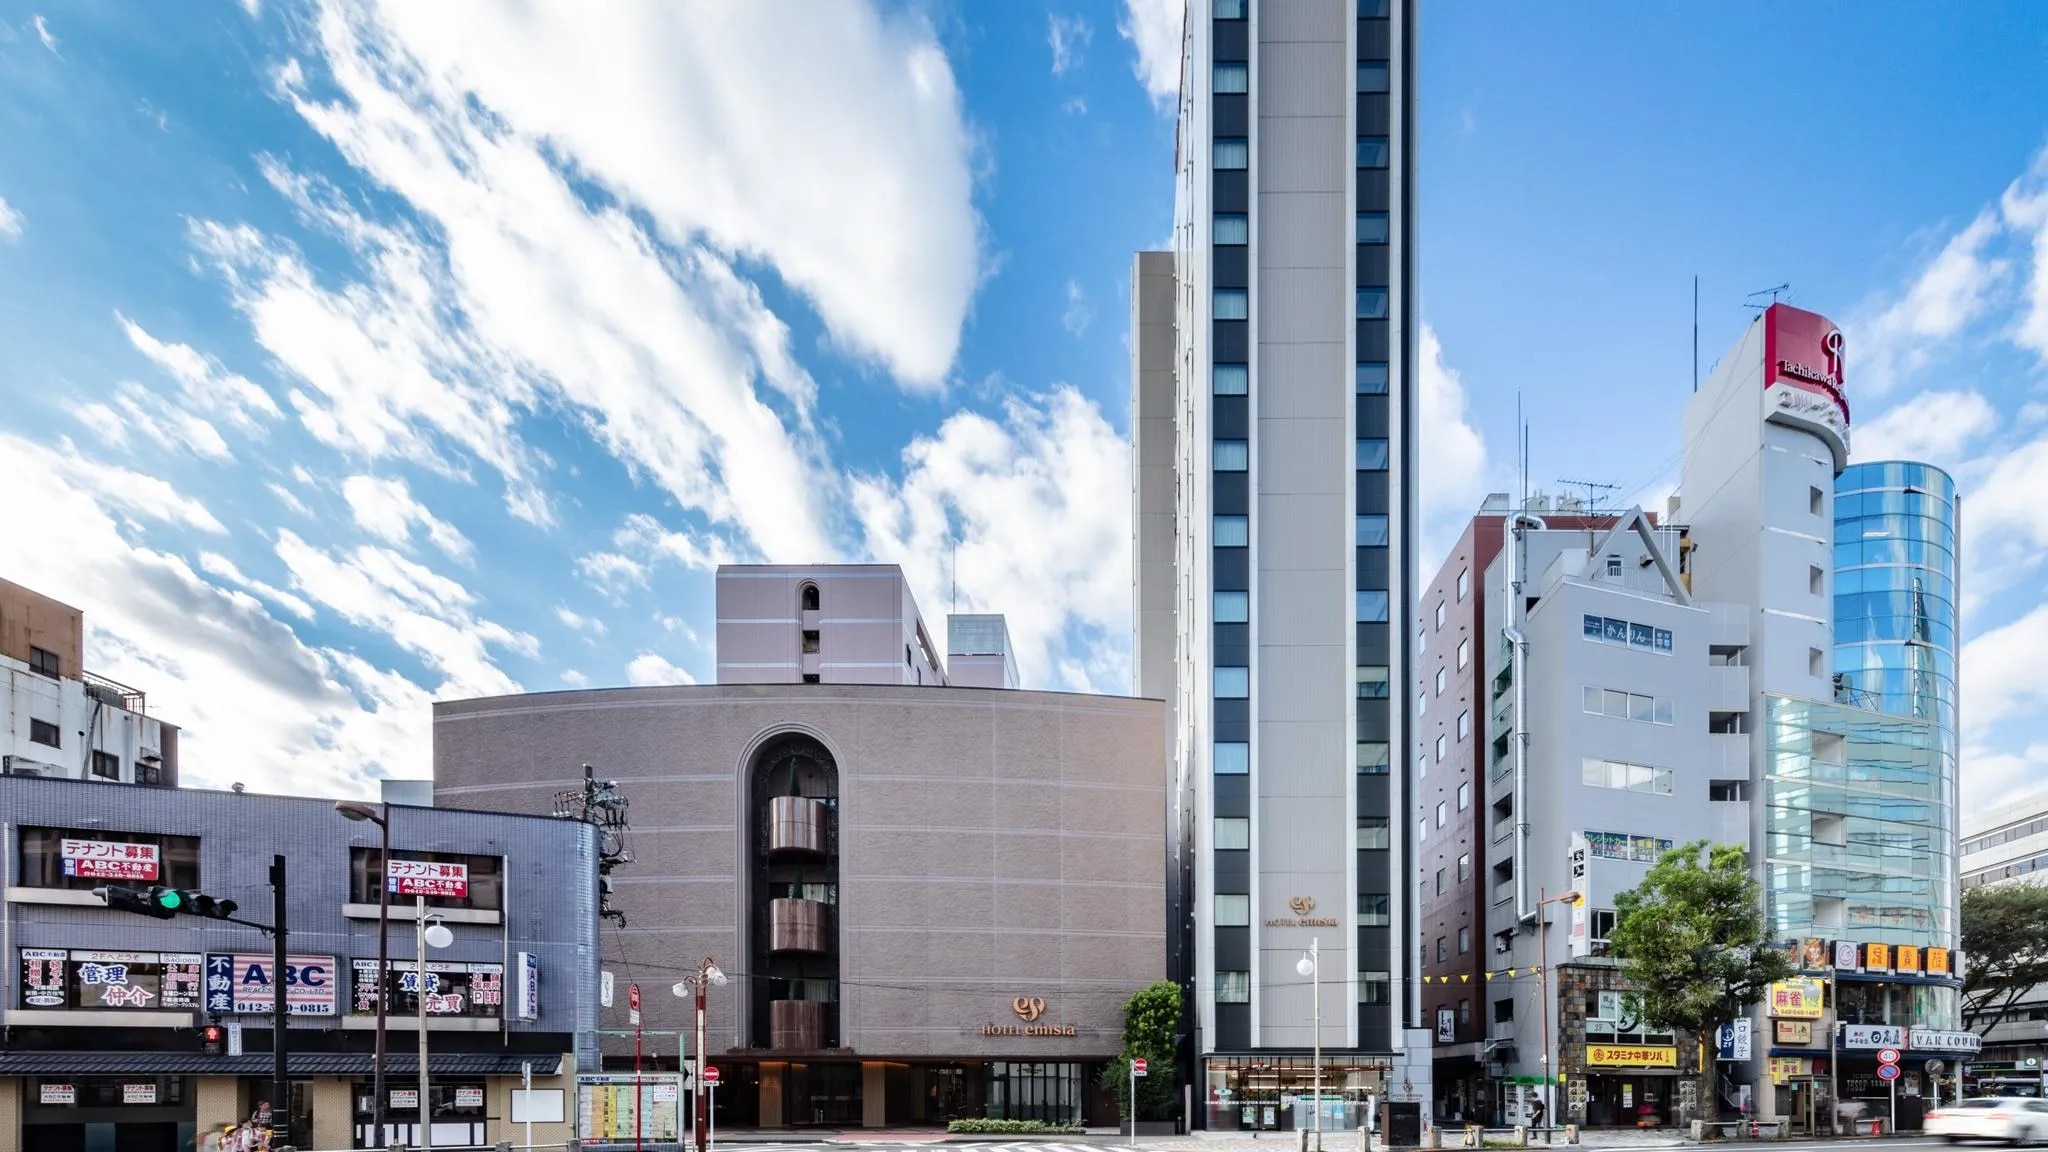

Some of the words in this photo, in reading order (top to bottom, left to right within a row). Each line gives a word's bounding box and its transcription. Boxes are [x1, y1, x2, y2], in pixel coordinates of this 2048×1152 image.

[1783, 360, 1833, 386] Tachikawa
[66, 842, 154, 859] テナント募集
[81, 860, 152, 872] ABC不動産
[391, 862, 464, 877] テナント募集
[402, 879, 463, 889] ABC不動産
[81, 963, 128, 984] 管理
[242, 964, 326, 987] ABC
[208, 956, 231, 1010] 不動産
[103, 986, 152, 1006] 仲介
[427, 994, 462, 1012] 売買
[1776, 991, 1801, 1006] 麻雀
[238, 1003, 329, 1013] 042-50-0815
[982, 1025, 1021, 1035] HOTEL
[1024, 1025, 1076, 1036] emisia
[1916, 1035, 1941, 1046] VAN
[1607, 1050, 1663, 1061] スタミナ中華ソバ
